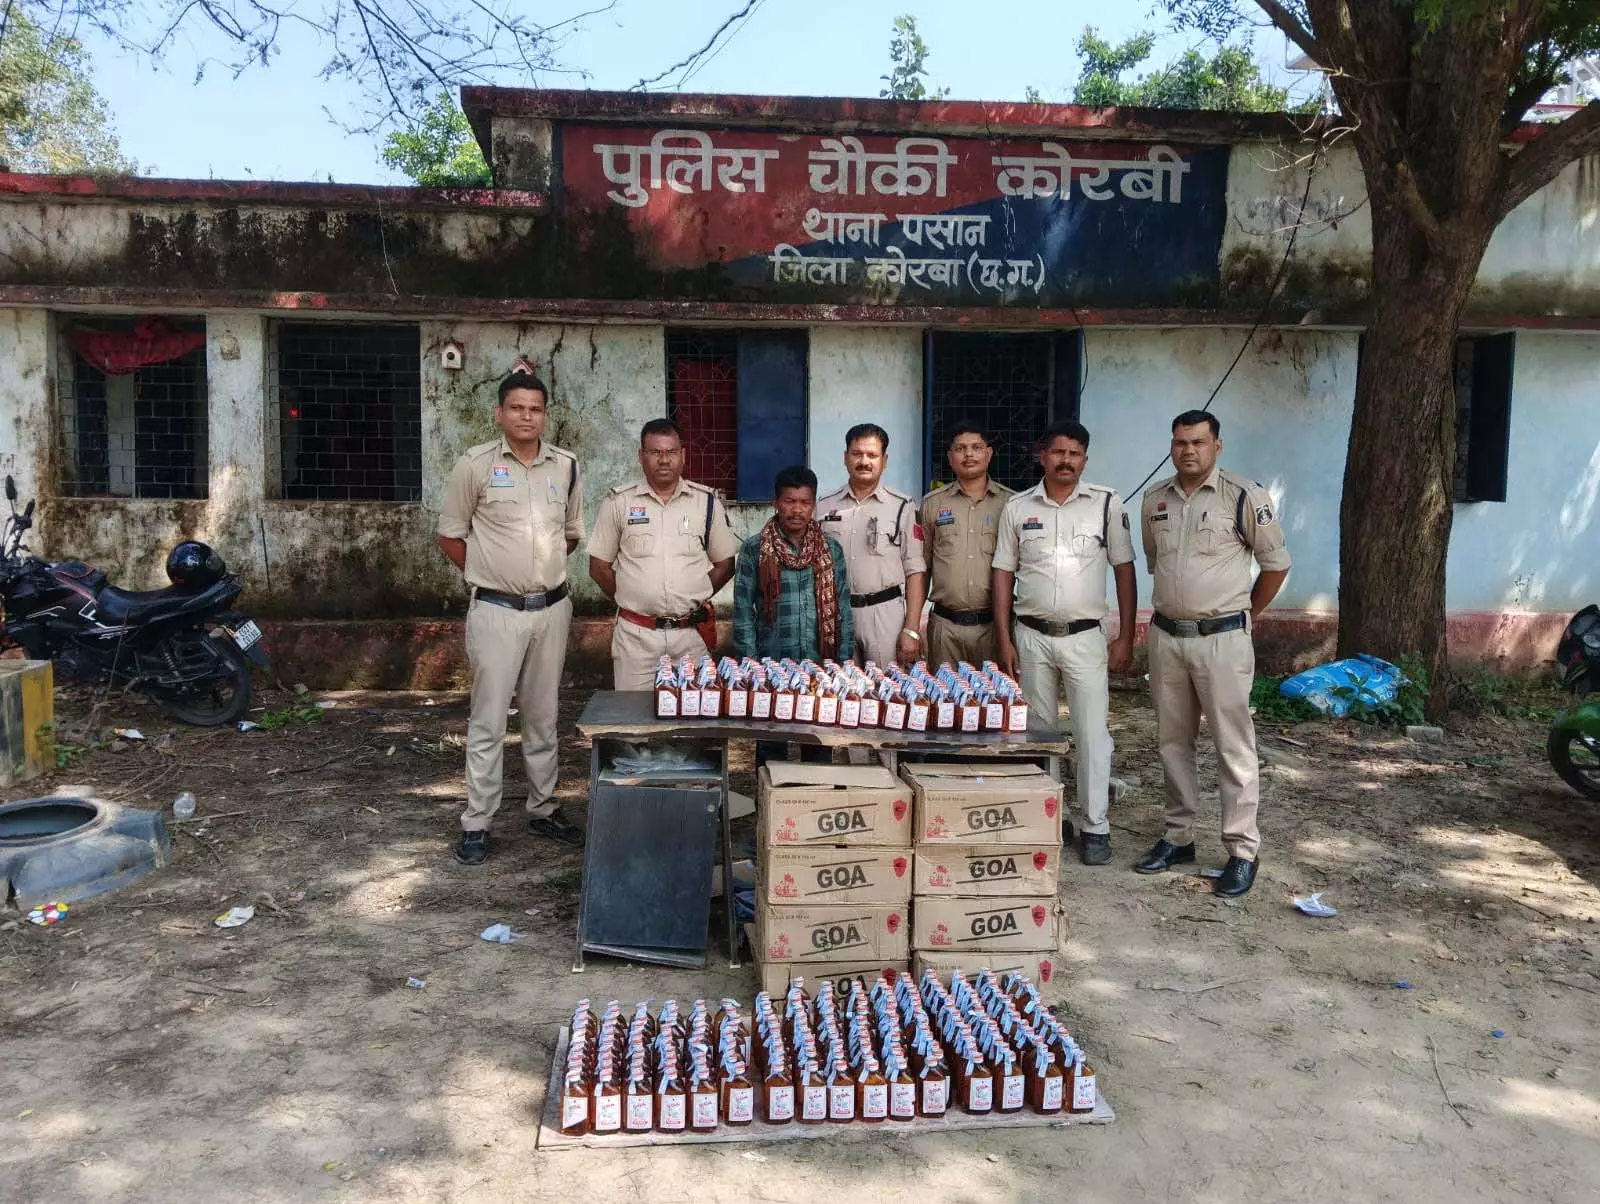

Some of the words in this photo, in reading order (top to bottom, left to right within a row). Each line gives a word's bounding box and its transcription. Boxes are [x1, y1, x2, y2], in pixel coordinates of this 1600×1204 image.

[593, 129, 779, 207] पुलिस
[808, 136, 957, 197] चौकी
[992, 142, 1190, 203] कोरबी
[802, 207, 888, 246] थाना
[896, 214, 992, 250] पसान
[768, 243, 854, 285] जिला
[864, 246, 966, 290] कोरबा
[817, 810, 867, 833] GOA
[967, 807, 1017, 830] GOA
[816, 865, 867, 889] GOA
[969, 857, 1018, 879] GOA
[971, 912, 1017, 936] GOA
[811, 924, 861, 949] GOA
